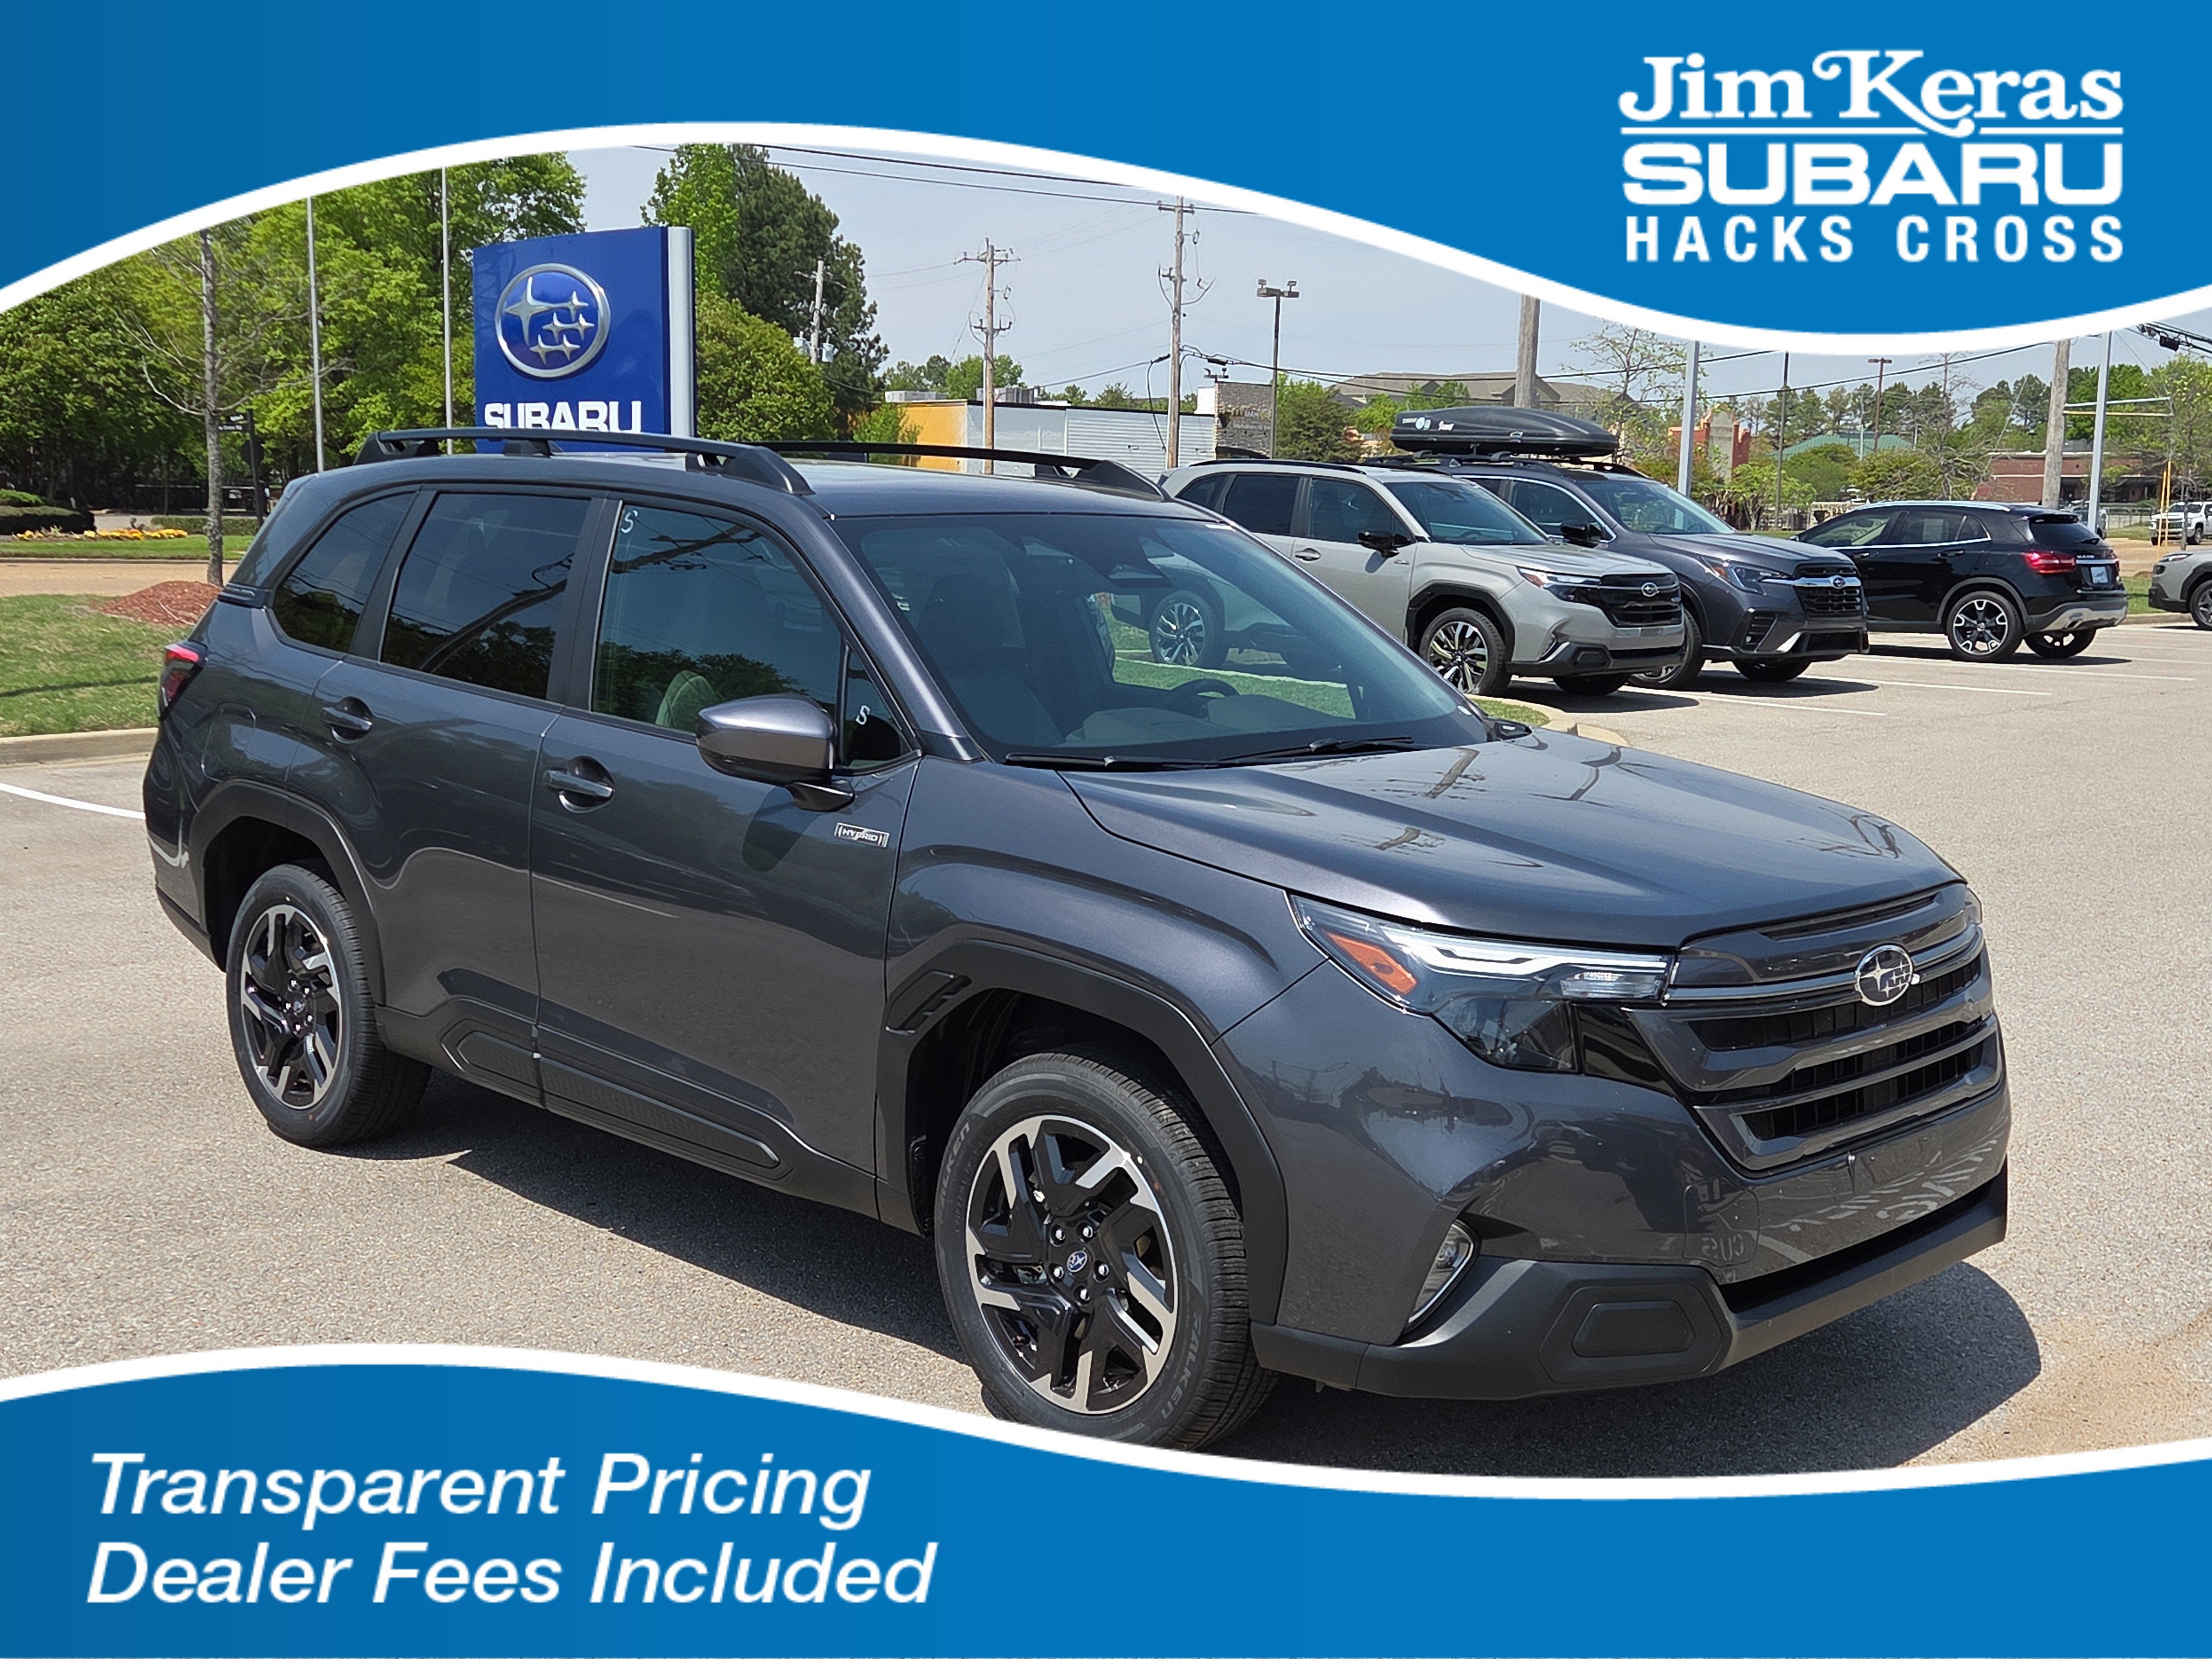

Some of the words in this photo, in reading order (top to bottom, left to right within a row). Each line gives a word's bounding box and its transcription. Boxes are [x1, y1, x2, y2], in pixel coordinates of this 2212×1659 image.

[484, 400, 641, 433] SUBARU
[843, 828, 878, 841] HYBRID
[1161, 1311, 1202, 1419] FALKEN
